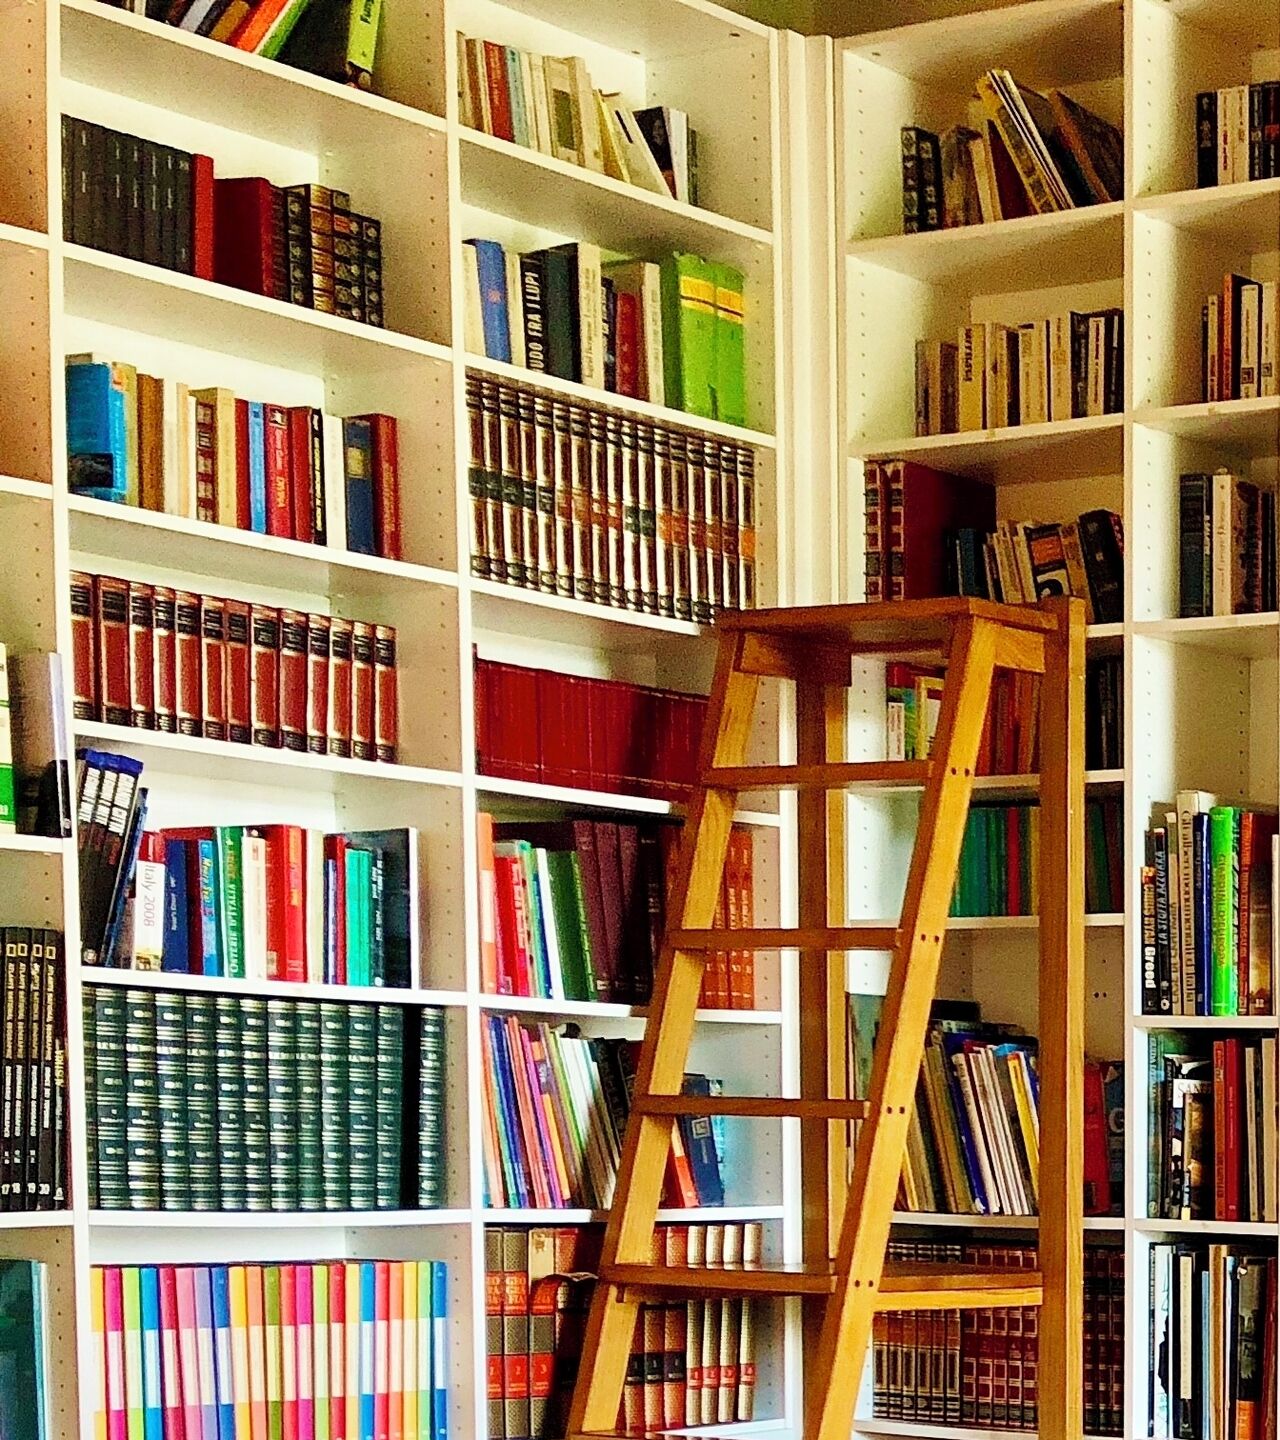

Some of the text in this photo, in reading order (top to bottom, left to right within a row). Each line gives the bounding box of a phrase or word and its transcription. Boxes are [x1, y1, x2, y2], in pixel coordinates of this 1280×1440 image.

[524, 271, 541, 301] LUPI
[526, 313, 543, 337] FRA
[141, 864, 156, 928] Italy 2008
[226, 882, 239, 974] OSTERIE D'ITALIA
[1143, 916, 1156, 945] RYAN
[1143, 946, 1157, 990] Greed
